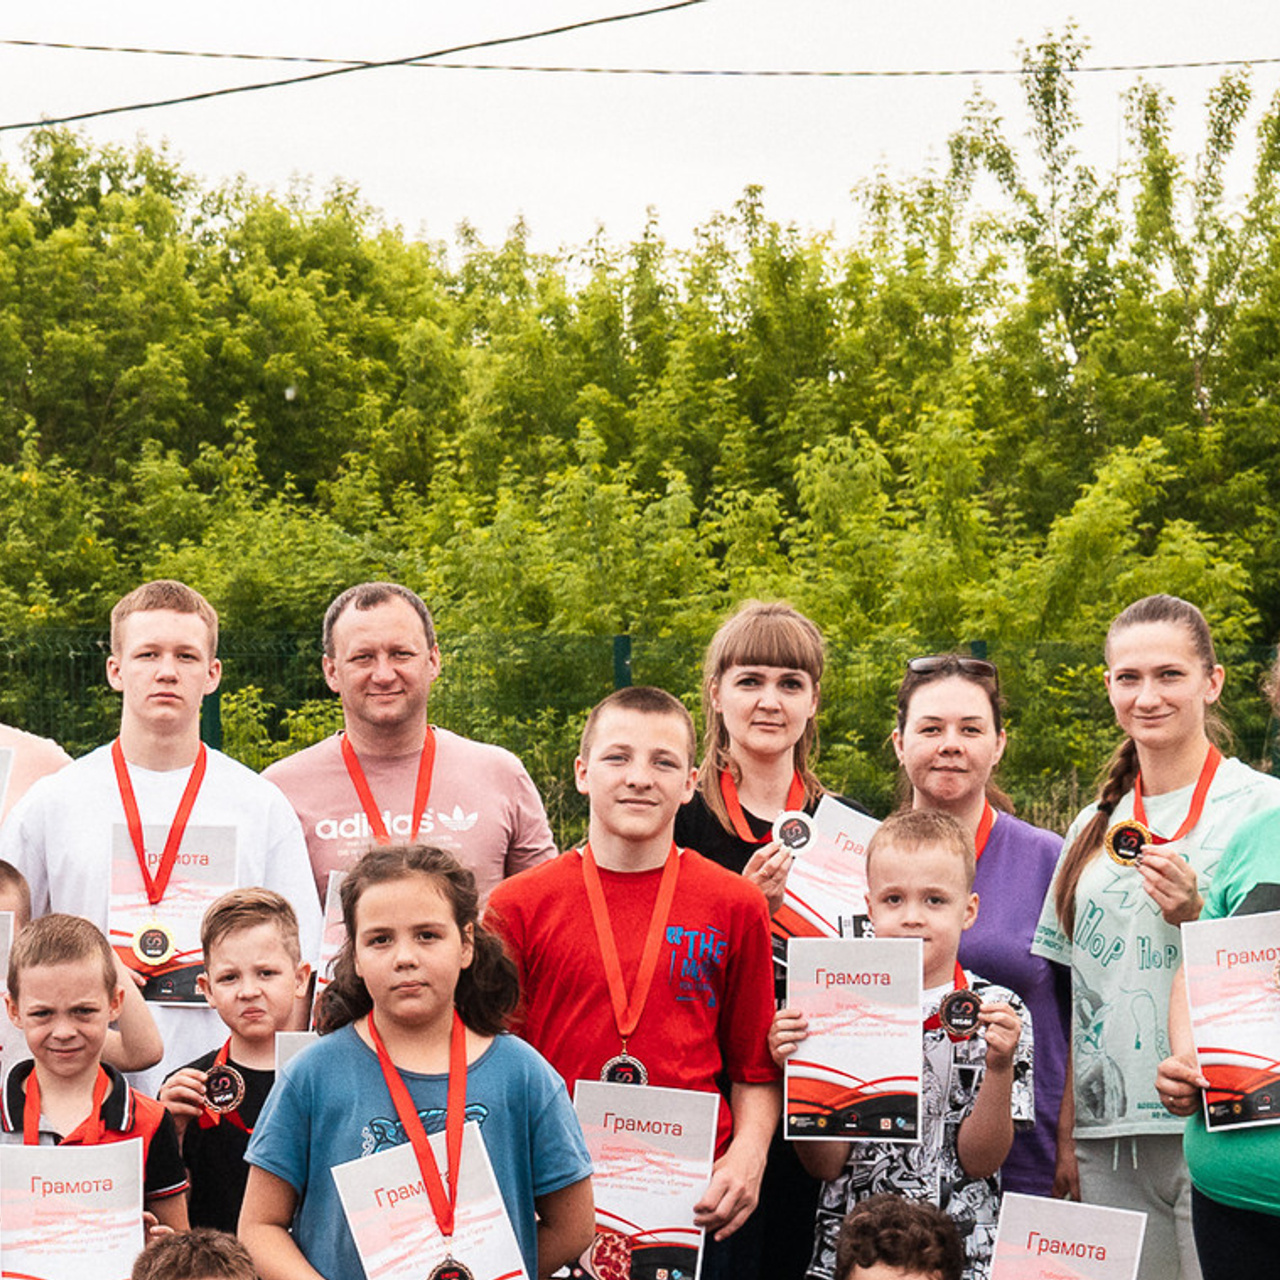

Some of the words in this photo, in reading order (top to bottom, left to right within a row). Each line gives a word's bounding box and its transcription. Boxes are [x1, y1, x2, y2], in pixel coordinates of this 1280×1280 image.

[815, 968, 891, 989] Грамота
[603, 1112, 683, 1136] Грамота
[30, 1176, 113, 1198] Грамота
[1026, 1231, 1107, 1260] Грамота
